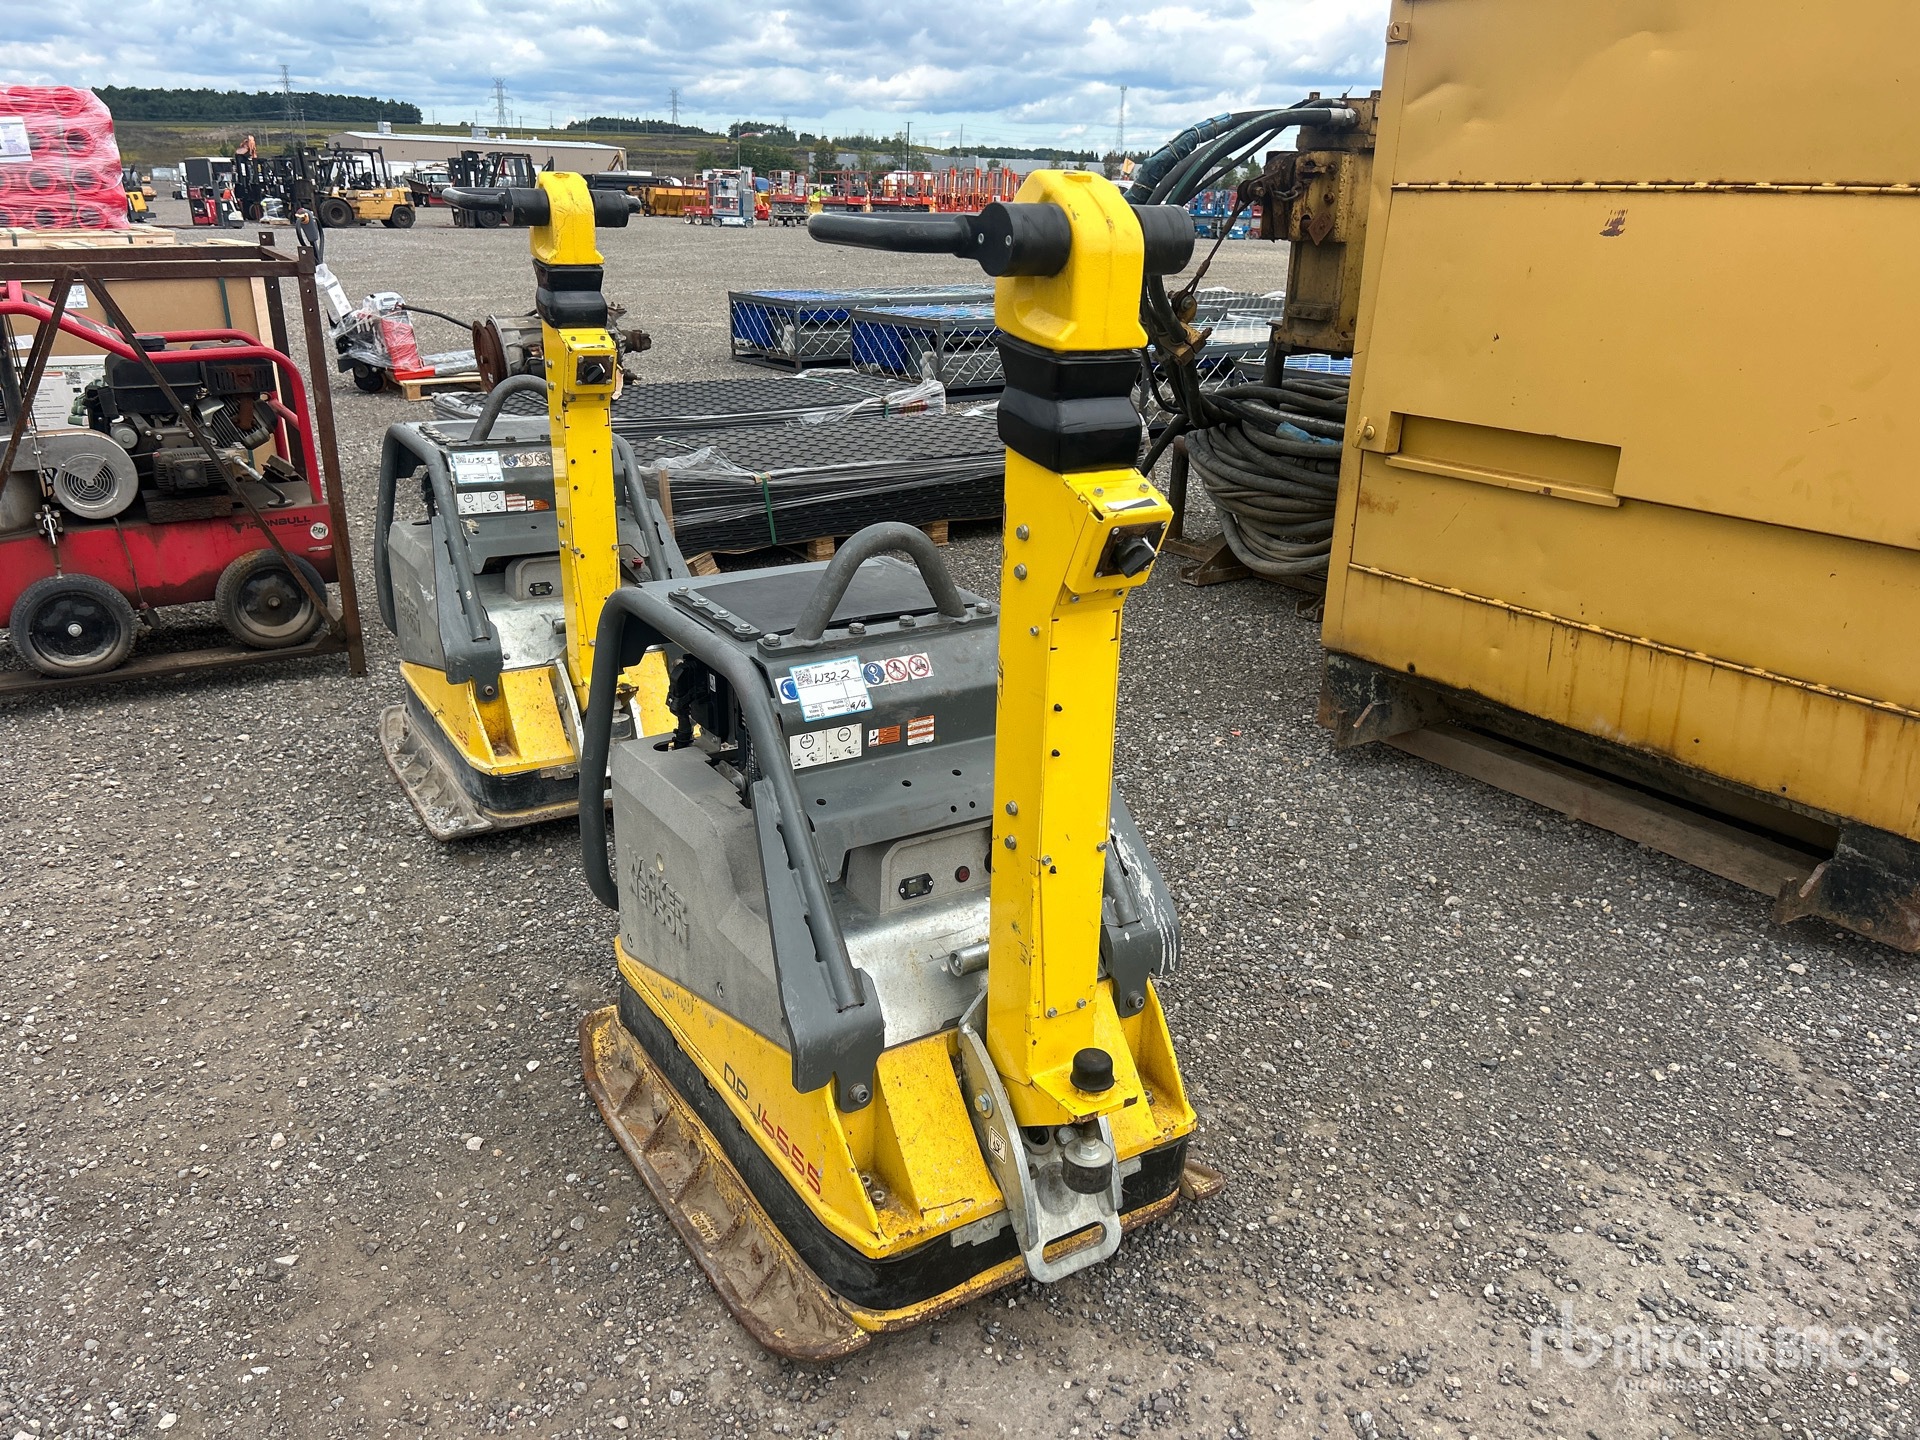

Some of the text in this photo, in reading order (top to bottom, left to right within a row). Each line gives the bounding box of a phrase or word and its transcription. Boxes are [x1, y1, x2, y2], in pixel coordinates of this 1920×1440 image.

[312, 526, 327, 534] PDI
[814, 669, 851, 684] W32-2
[625, 843, 688, 914] WACKER
[630, 875, 690, 951] NEUSON
